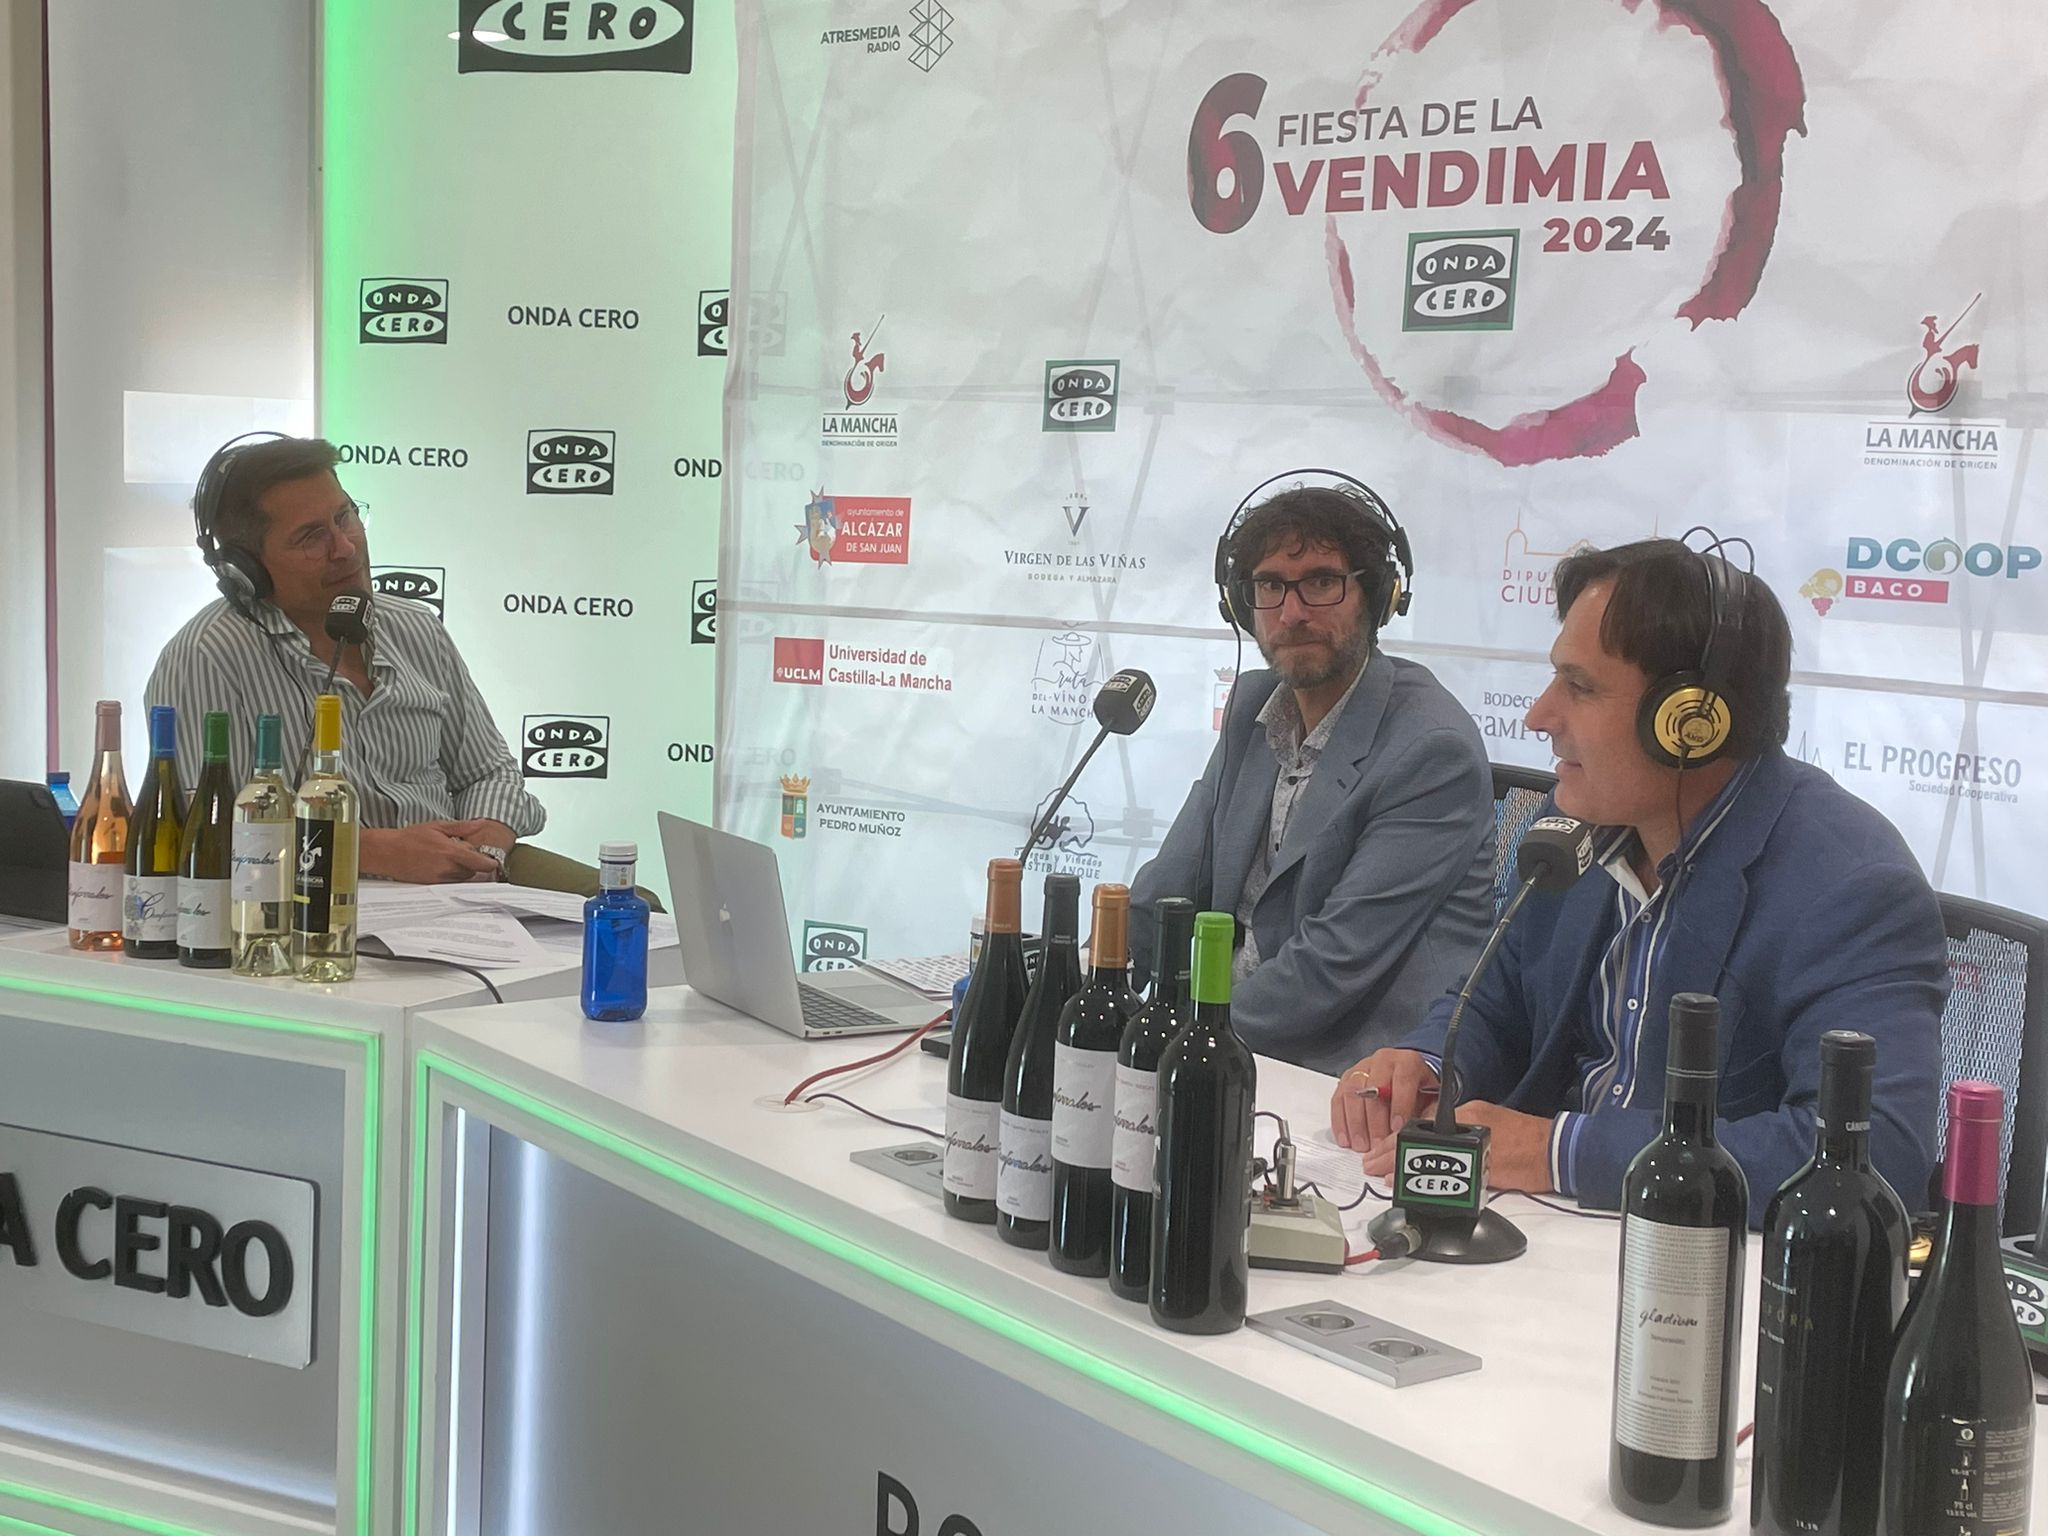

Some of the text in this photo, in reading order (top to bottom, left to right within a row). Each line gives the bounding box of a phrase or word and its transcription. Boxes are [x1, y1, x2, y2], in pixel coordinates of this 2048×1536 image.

[501, 2, 658, 41] CERO
[820, 25, 900, 44] ATRESMEDIA
[867, 40, 901, 54] RADIO
[1277, 96, 1543, 147] FIESTA DE LA
[1187, 72, 1268, 235] 6
[1272, 140, 1671, 216] VENDIMIA
[1542, 216, 1671, 253] 2024
[1424, 254, 1498, 276] ONDA
[372, 292, 436, 307] ONDA
[1426, 288, 1496, 311] CERO
[375, 317, 435, 333] CERO
[507, 306, 640, 330] ONDA CERO
[1057, 377, 1106, 392] ONDA
[1057, 401, 1105, 417] CERO
[822, 417, 898, 433] LA MANCHA
[1865, 427, 1999, 452] LA MANCHA
[341, 445, 469, 468] ONDA CERO
[539, 442, 602, 457] ONDA
[673, 457, 723, 479] OND
[1863, 457, 1998, 470] DENOMINACIÓN DE ORIGEN
[542, 469, 602, 485] CERO
[847, 508, 905, 518] ayuntamiento de
[841, 518, 904, 538] ALCÁZAR
[846, 542, 903, 554] DE SAN JUAN
[1846, 536, 2043, 579] DCOOP
[1004, 550, 1147, 570] VIRGEN DE LAS VIÑAS
[372, 579, 431, 592] ONDA
[1027, 573, 1065, 582] BODEGA
[1076, 575, 1118, 584] ALMAZARA
[1853, 580, 1924, 598] BACO
[503, 593, 634, 618] ONDA CERO
[829, 644, 928, 666] Universidad de
[783, 668, 822, 681] UCLM
[828, 666, 953, 692] Castilla-La Mancha
[1031, 704, 1094, 718] LA MANCH
[534, 727, 597, 742] ONDA
[537, 751, 596, 767] CERO
[667, 742, 714, 763] OND
[1843, 741, 2022, 788] EL PROGRESO
[1908, 779, 2019, 804] Sociedad Cooperativa
[816, 803, 906, 822] AYUNTAMIENTO
[819, 818, 902, 837] PEDRO MUÑOZ
[813, 938, 856, 954] ONDA
[1412, 1157, 1462, 1173] ONDA
[1415, 1178, 1461, 1192] CERO
[55, 1185, 294, 1317] CERO
[2005, 1279, 2039, 1300] NDA
